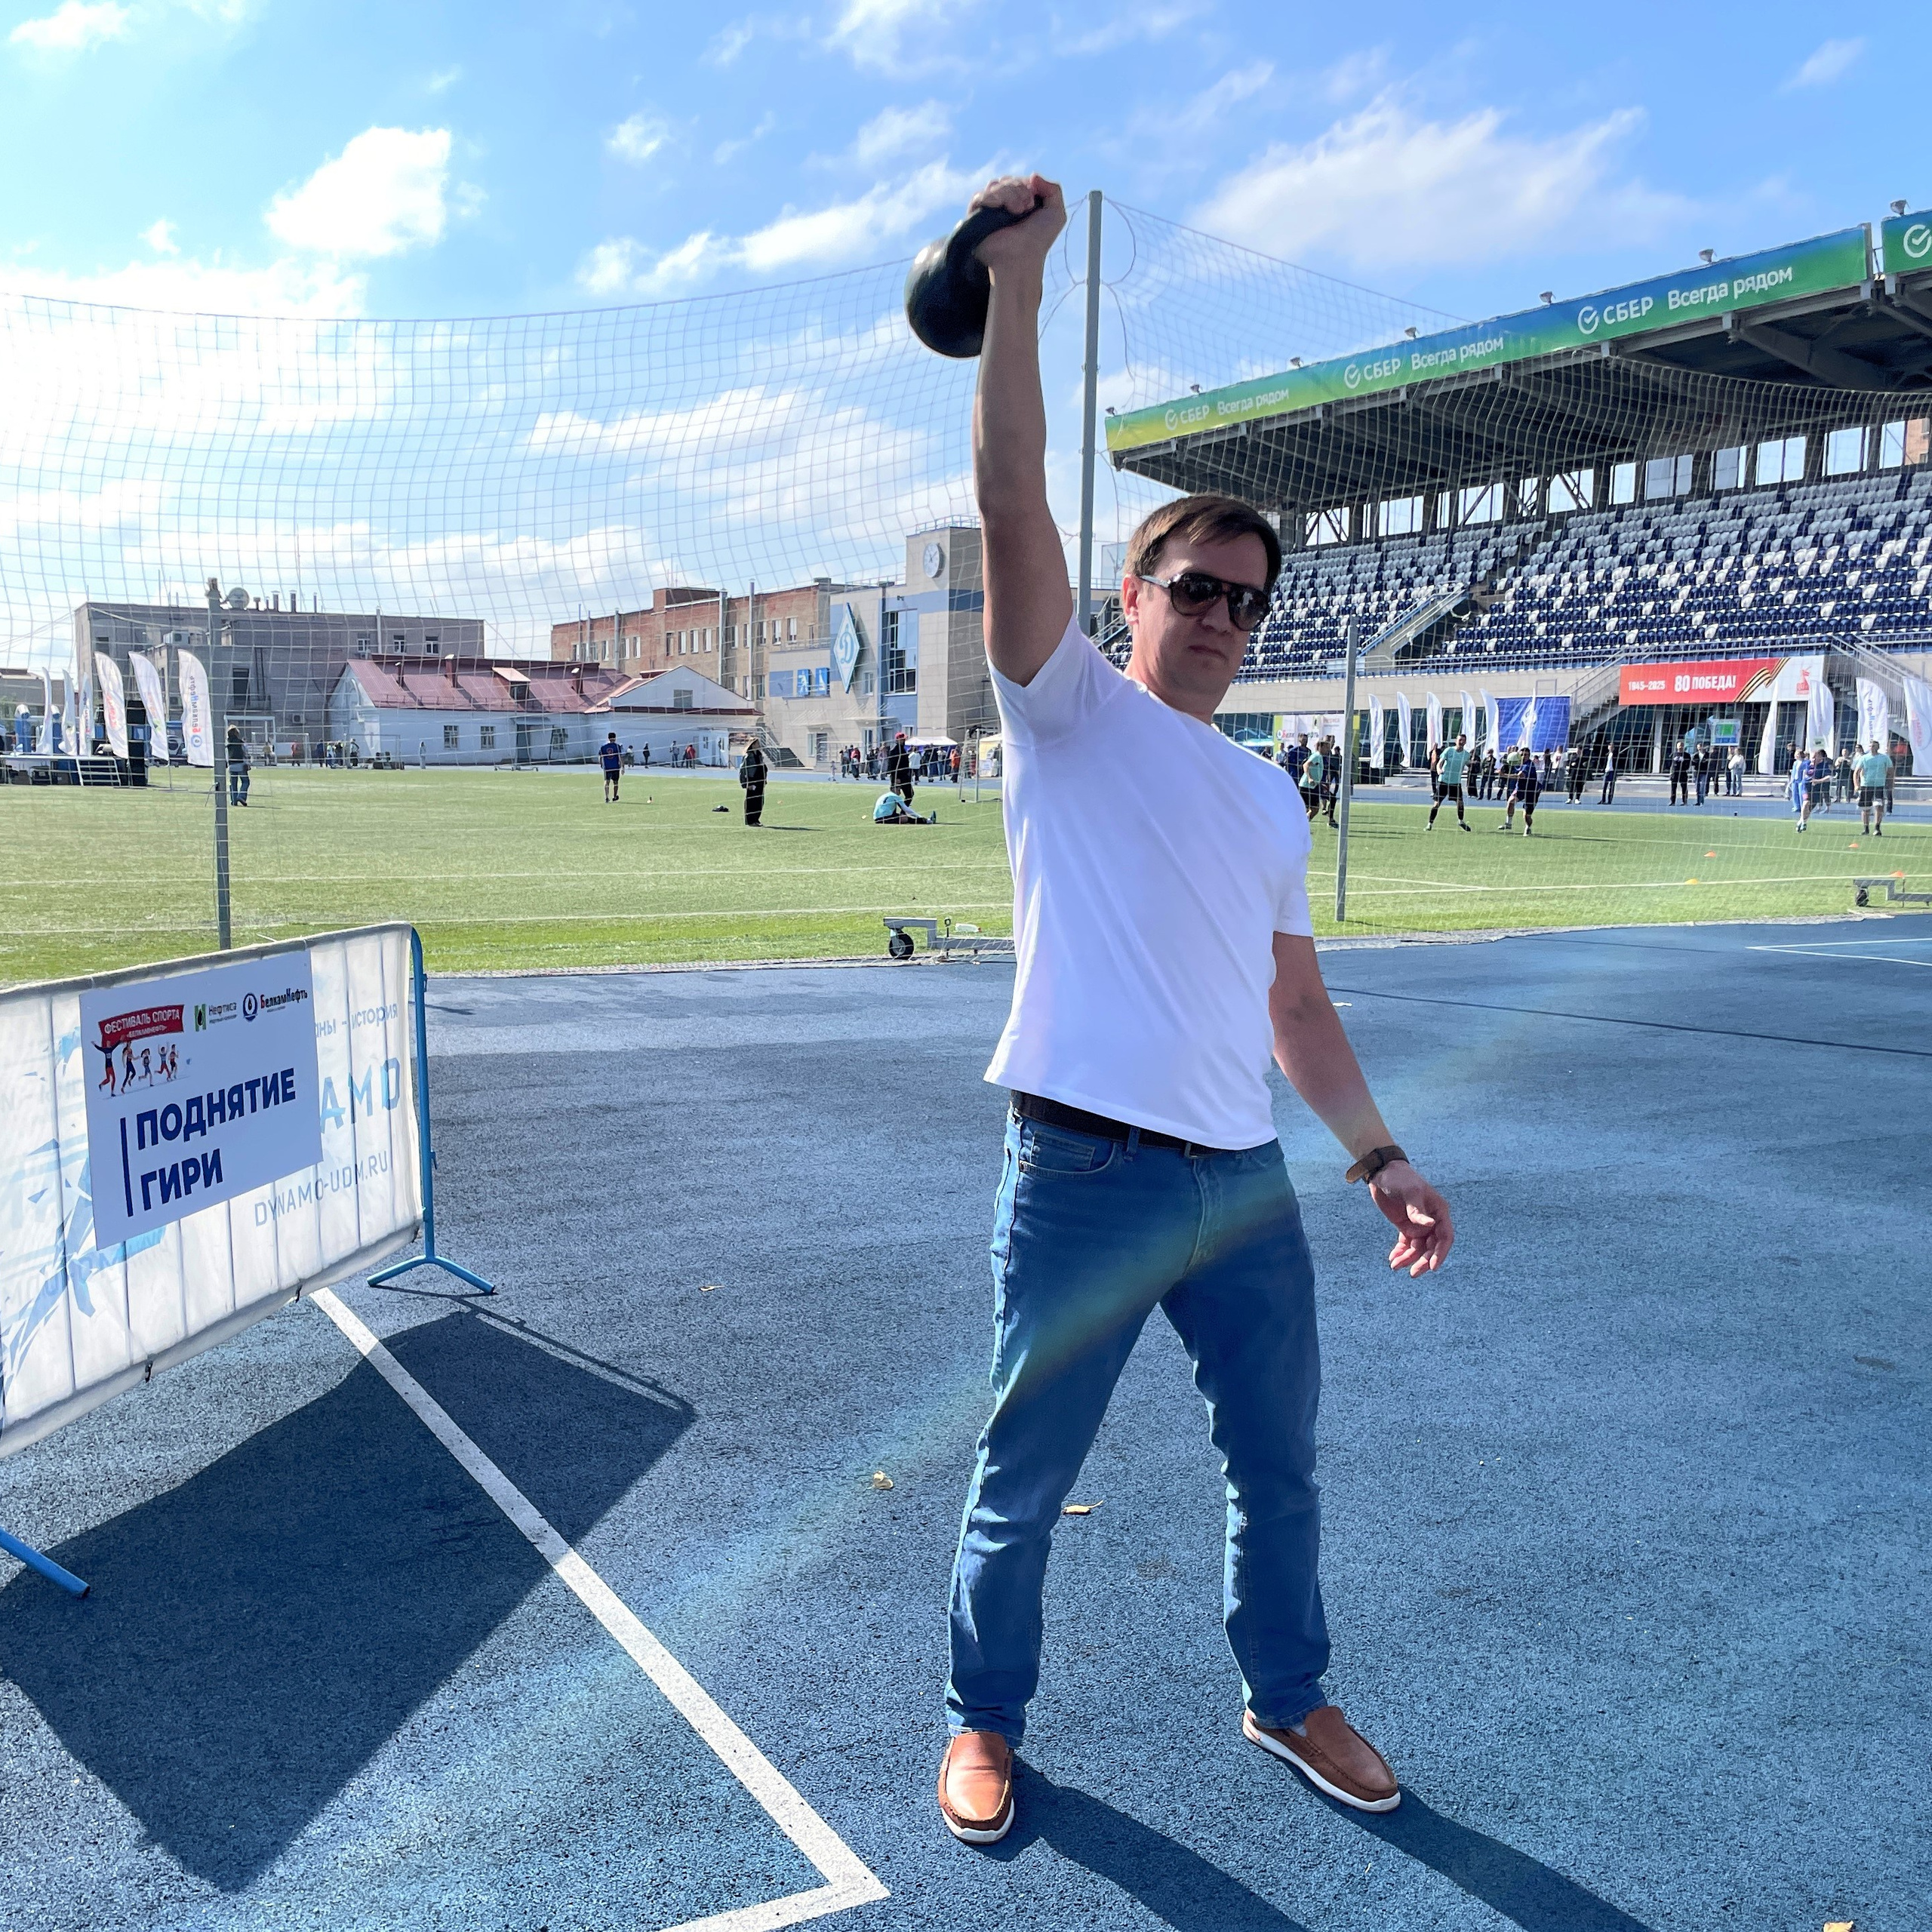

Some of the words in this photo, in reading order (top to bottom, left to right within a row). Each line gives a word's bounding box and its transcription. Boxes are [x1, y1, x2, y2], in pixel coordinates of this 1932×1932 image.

[1603, 297, 1654, 325] СБЕР
[1668, 283, 1728, 310] Всегда
[1734, 266, 1793, 300] рядом
[1363, 358, 1401, 380] СБЕР
[1411, 348, 1457, 371] Всегда
[1460, 337, 1504, 362] рядом
[1180, 405, 1210, 424] СБЕР
[1217, 400, 1254, 416] Всегда
[1256, 388, 1290, 409] рядом
[1675, 675, 1690, 692] 80
[1691, 675, 1737, 691] ПОБЕДА!
[260, 988, 308, 1009] БелкамНефть
[104, 1013, 150, 1034] ФЕСТИВАЛЬ
[152, 1009, 180, 1023] СПОРТА
[137, 1067, 296, 1151] ПОДНЯТИЕ
[140, 1148, 223, 1212] ГИРИ
[254, 1150, 389, 1227] DYNAMO-UDM.RU
